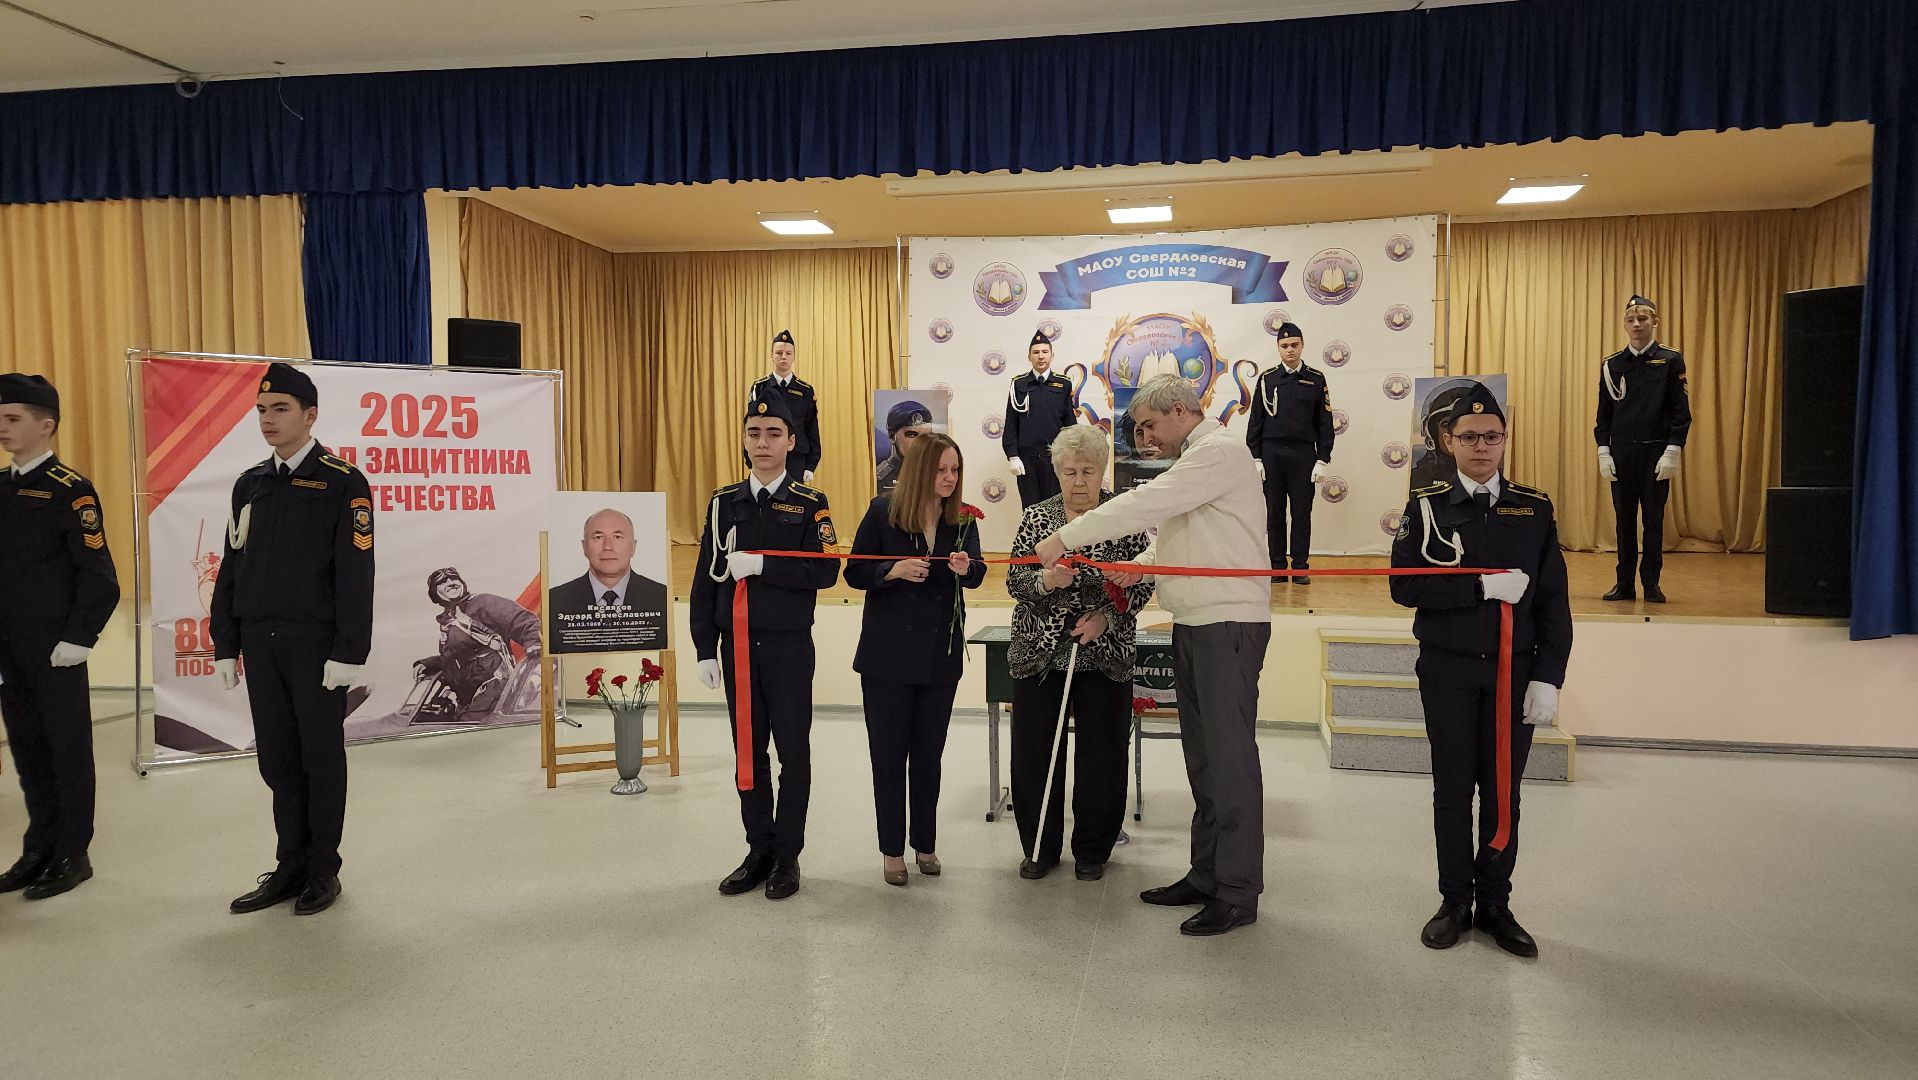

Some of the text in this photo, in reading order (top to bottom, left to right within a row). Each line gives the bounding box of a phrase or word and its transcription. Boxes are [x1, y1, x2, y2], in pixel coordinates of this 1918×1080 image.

[1077, 252, 1247, 276] МАОУ Свердловская
[1125, 266, 1197, 280] СОШ №2
[360, 391, 479, 439] 2025
[365, 446, 531, 478] ЗАЩИТНИКА
[370, 484, 496, 511] ТЕЧЕСТВА
[557, 613, 592, 621] Эдуард
[1135, 666, 1160, 677] АРТА
